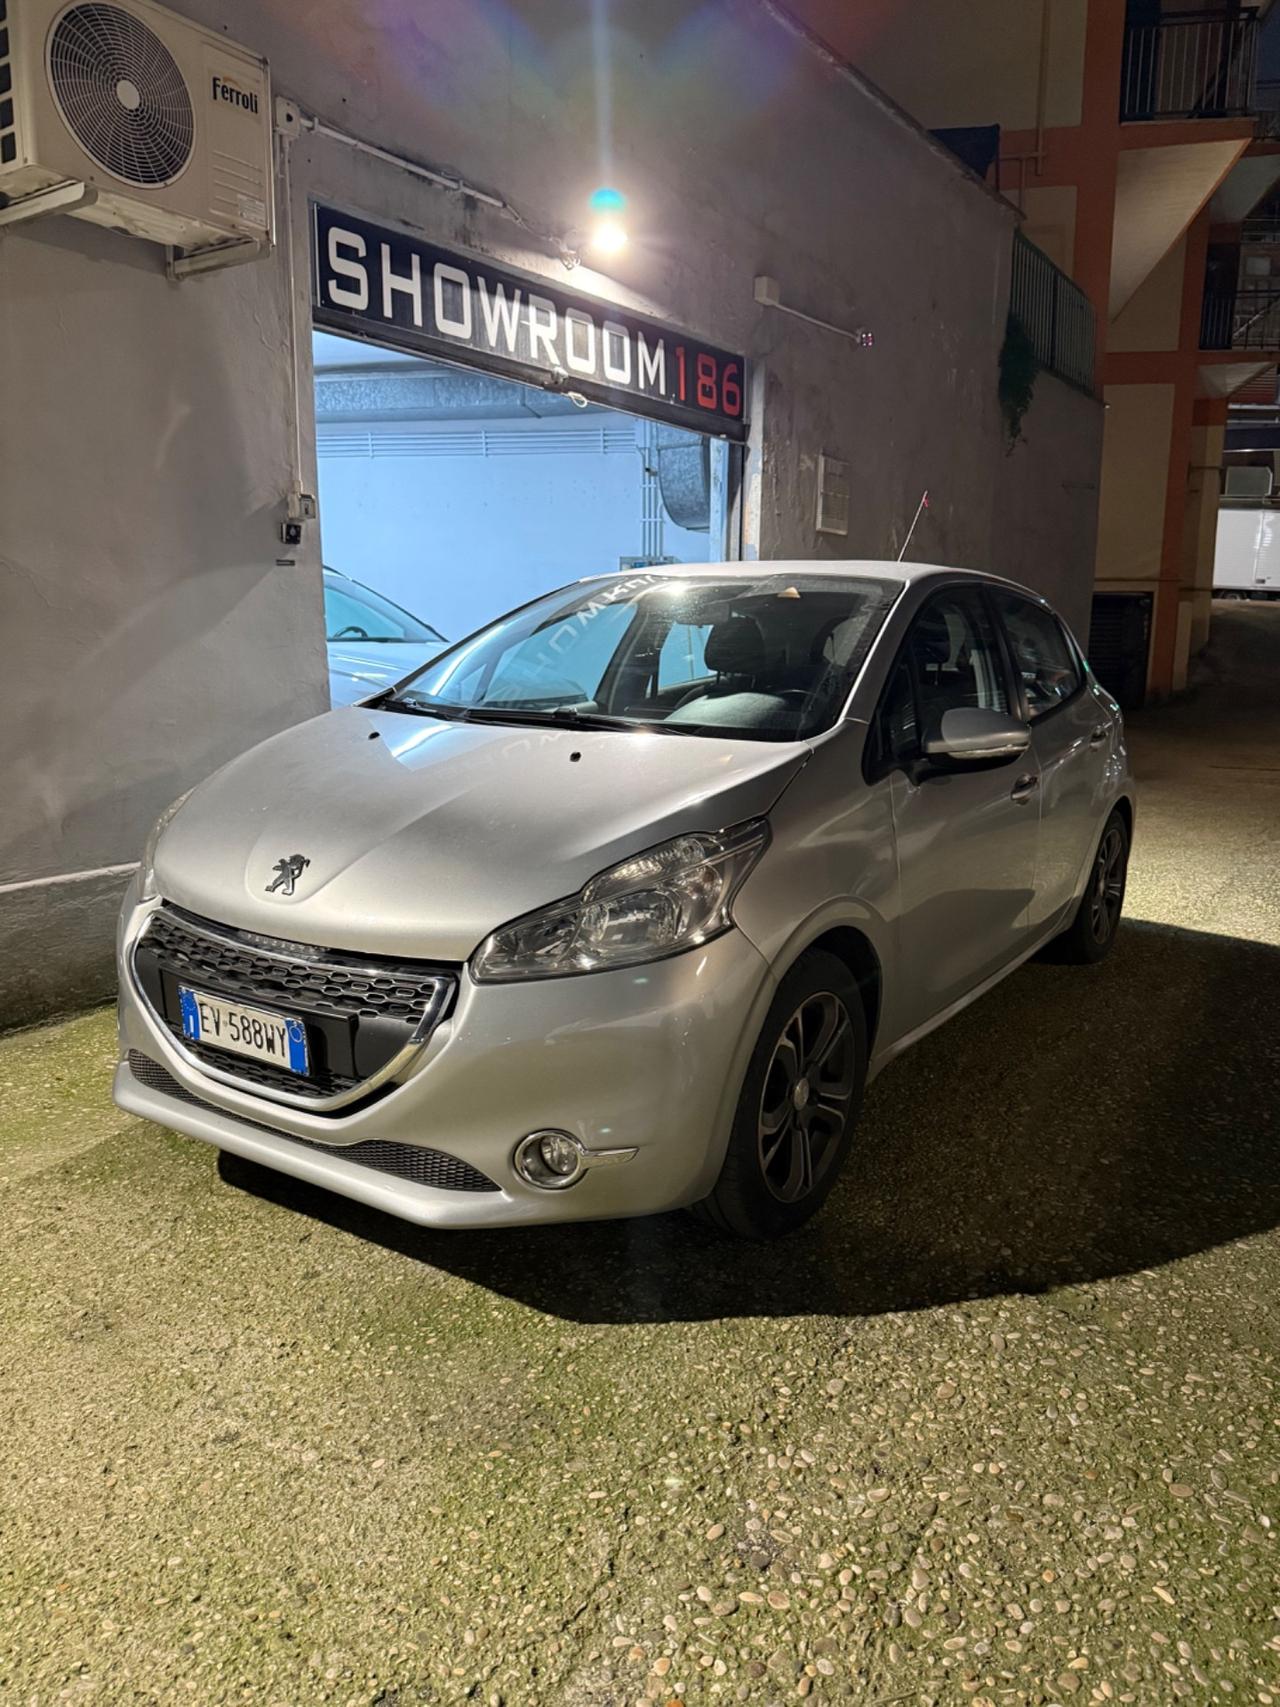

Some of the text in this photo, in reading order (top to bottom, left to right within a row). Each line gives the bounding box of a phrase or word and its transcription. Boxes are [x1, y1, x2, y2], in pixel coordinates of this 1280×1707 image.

[212, 76, 258, 115] Ferroli
[328, 226, 740, 417] SHOWROOM 186
